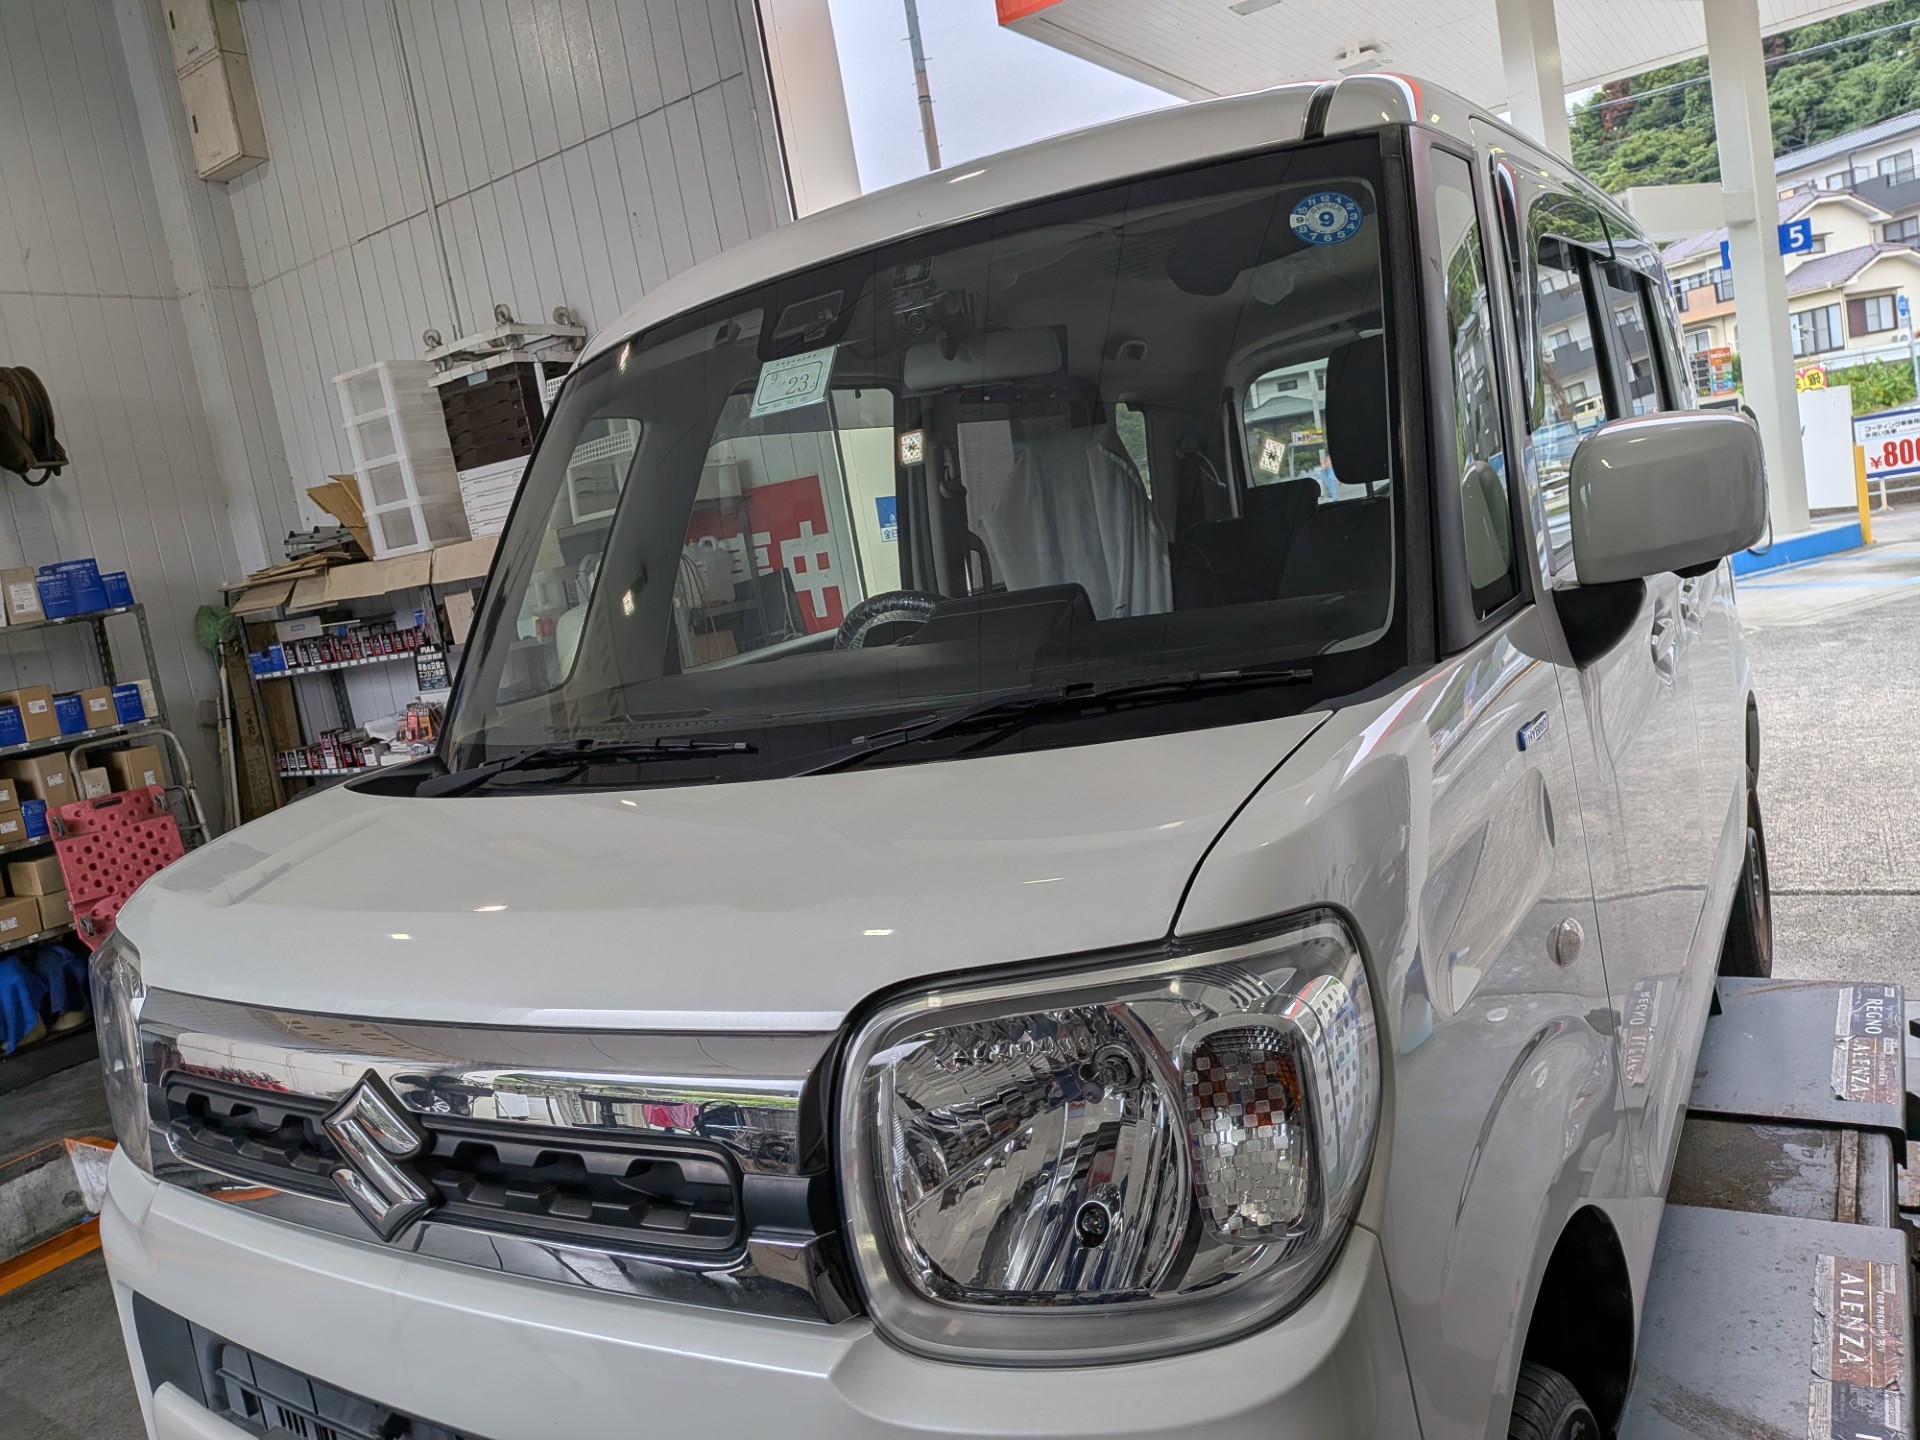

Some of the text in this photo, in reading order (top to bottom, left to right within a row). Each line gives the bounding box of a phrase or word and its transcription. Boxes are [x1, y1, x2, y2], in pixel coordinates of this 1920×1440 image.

[1296, 216, 1304, 224] 9
[1319, 211, 1335, 227] 9
[1789, 226, 1804, 248] 5
[785, 373, 810, 396] 23
[420, 645, 435, 653] PIAA
[1865, 998, 1883, 1035] REGNO
[1851, 1043, 1871, 1092] ALENZA
[1876, 1291, 1885, 1304] FOR
[1839, 1272, 1865, 1364] ALENZA
